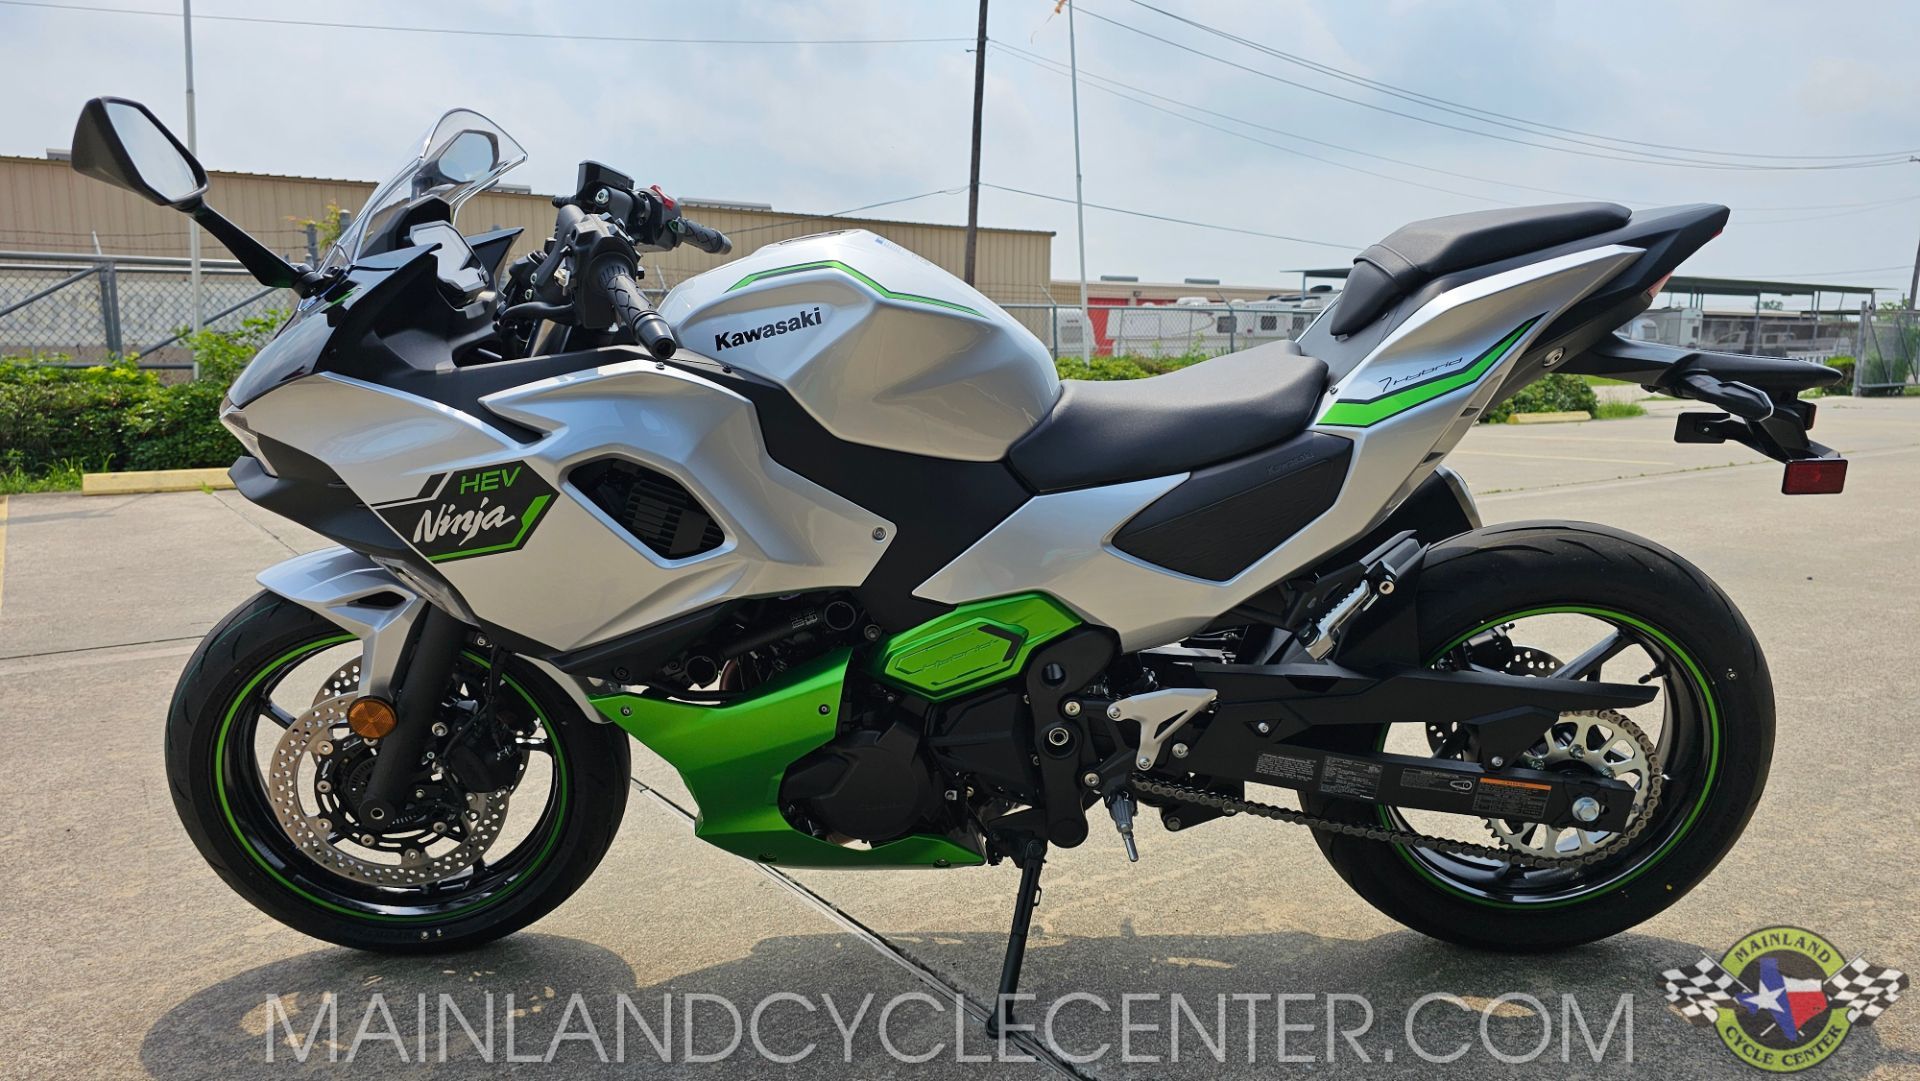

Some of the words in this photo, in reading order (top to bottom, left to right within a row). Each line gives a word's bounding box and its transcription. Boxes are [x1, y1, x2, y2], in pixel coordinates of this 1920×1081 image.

[714, 307, 822, 352] Kawasaki
[460, 466, 522, 495] HEV
[413, 496, 516, 547] Ninja
